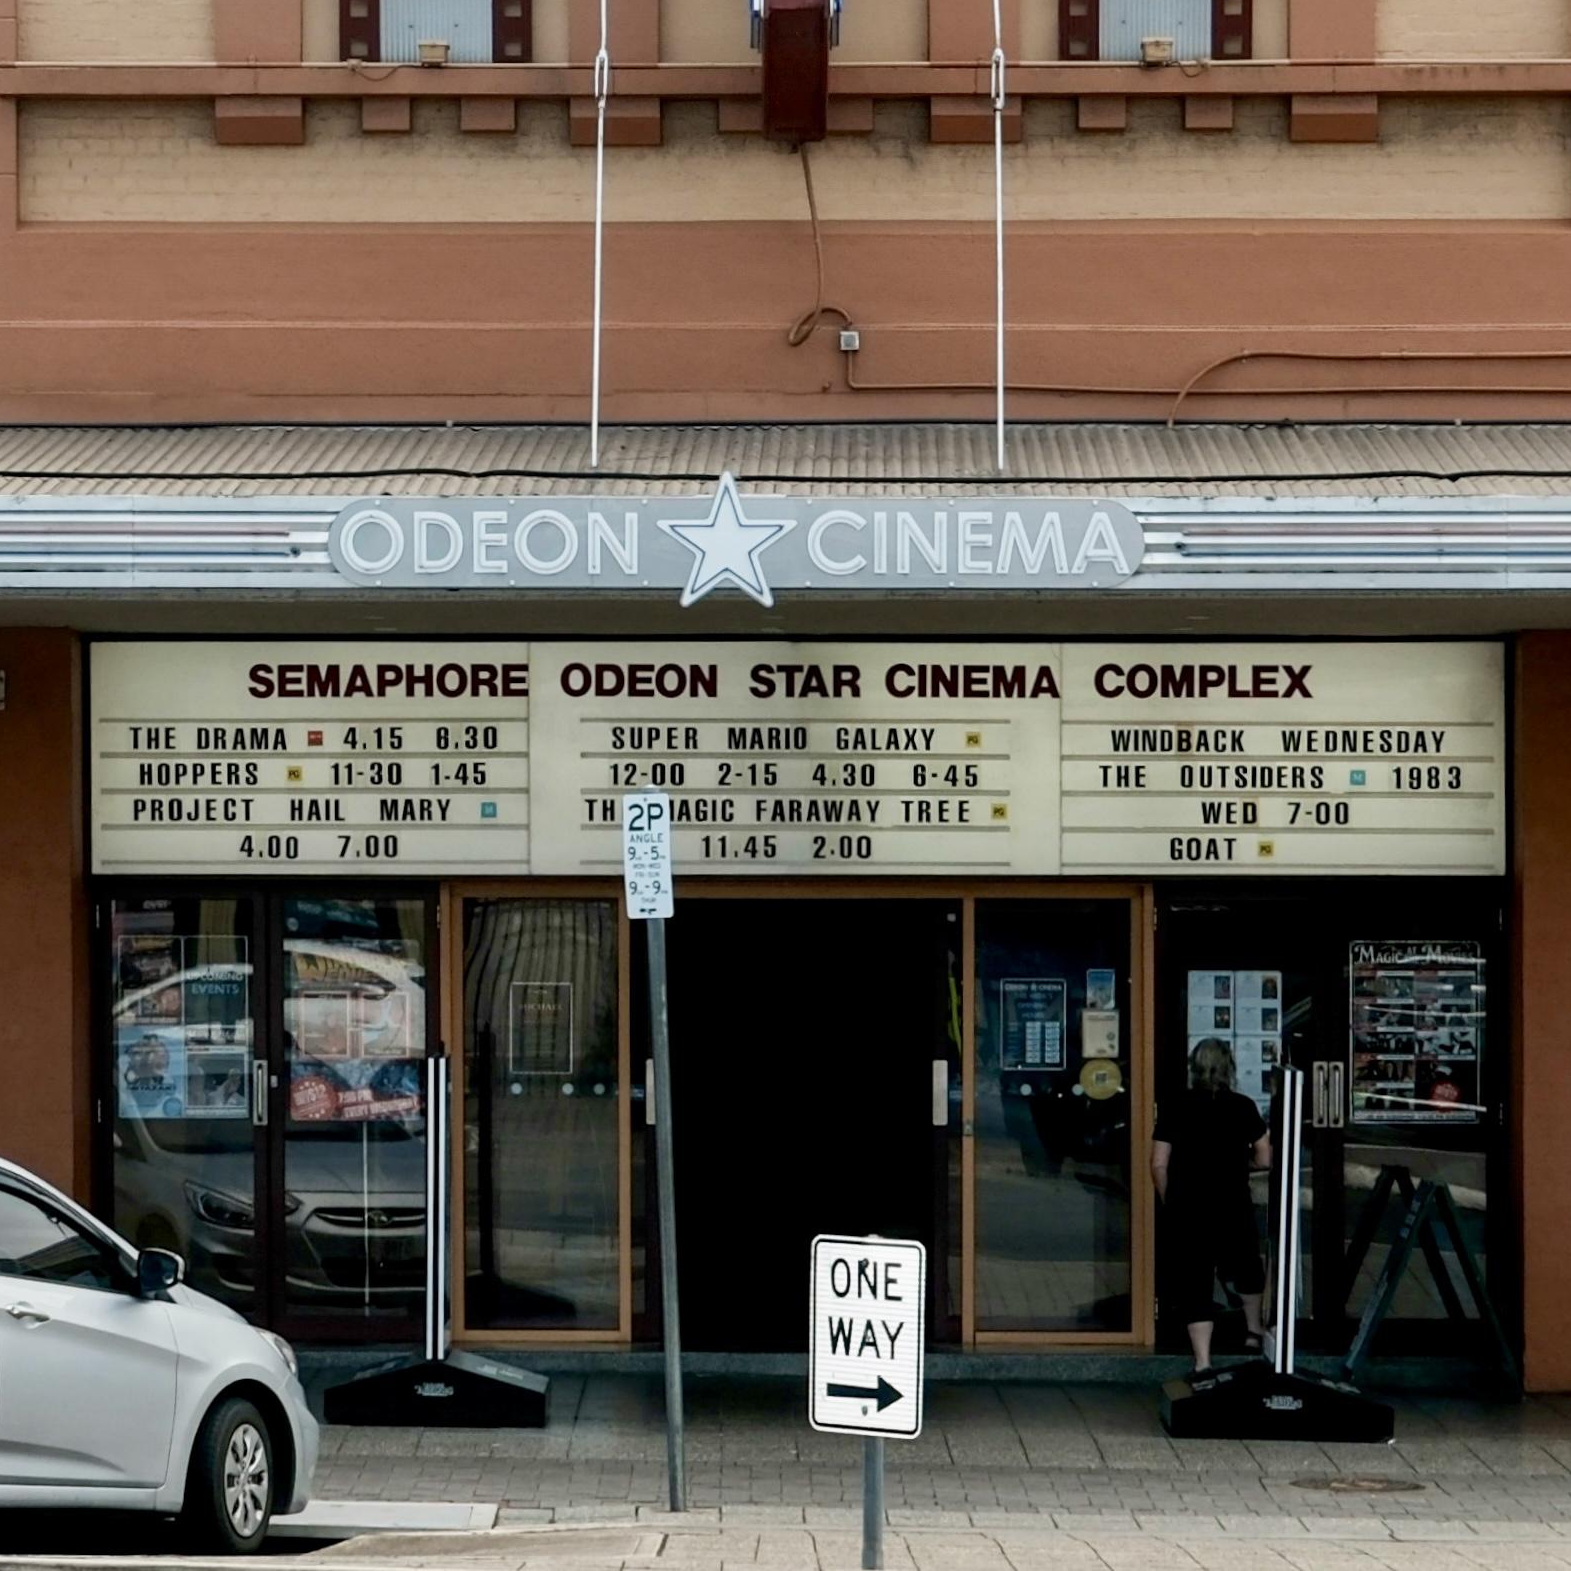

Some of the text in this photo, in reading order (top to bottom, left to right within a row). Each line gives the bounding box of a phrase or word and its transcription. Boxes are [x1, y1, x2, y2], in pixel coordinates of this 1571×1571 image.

[338, 509, 1131, 576] ODEON CINEMA
[247, 663, 1314, 700] SEMAPHORE ODEON STAR CINEMA COMPLEX
[129, 727, 177, 750] THE
[196, 727, 288, 751] DRAMA
[342, 726, 403, 750] 4.15
[612, 726, 698, 750] SUPER
[727, 726, 807, 751] MARIO
[836, 727, 935, 751] GALAXY
[1111, 729, 1446, 754] WINDBACK WEDNESDAY
[139, 762, 259, 786] HOPPERS
[330, 761, 403, 786] 11-30
[430, 762, 487, 786] 1-45
[609, 762, 979, 788] 12-00 2-15 4.30 6-45
[1098, 765, 1146, 789] THE
[1180, 764, 1324, 789] OUTSIDERS
[1391, 765, 1462, 790] 1983
[133, 797, 254, 822] PROJECT
[290, 798, 346, 822] HAIL
[379, 798, 451, 822] MARY
[584, 798, 616, 822] TH
[755, 798, 881, 823] FARAWAY
[901, 799, 971, 823] TREE
[628, 802, 663, 831] 2P
[1201, 801, 1350, 826] WED 7-00
[239, 834, 399, 859] 4.00 7.00
[630, 833, 664, 843] ANGLE
[701, 835, 777, 859] 11.45
[1170, 836, 1238, 861] GOAT
[190, 983, 240, 995] EVENTS
[830, 1257, 904, 1302] ONE
[828, 1315, 905, 1361] WAY
